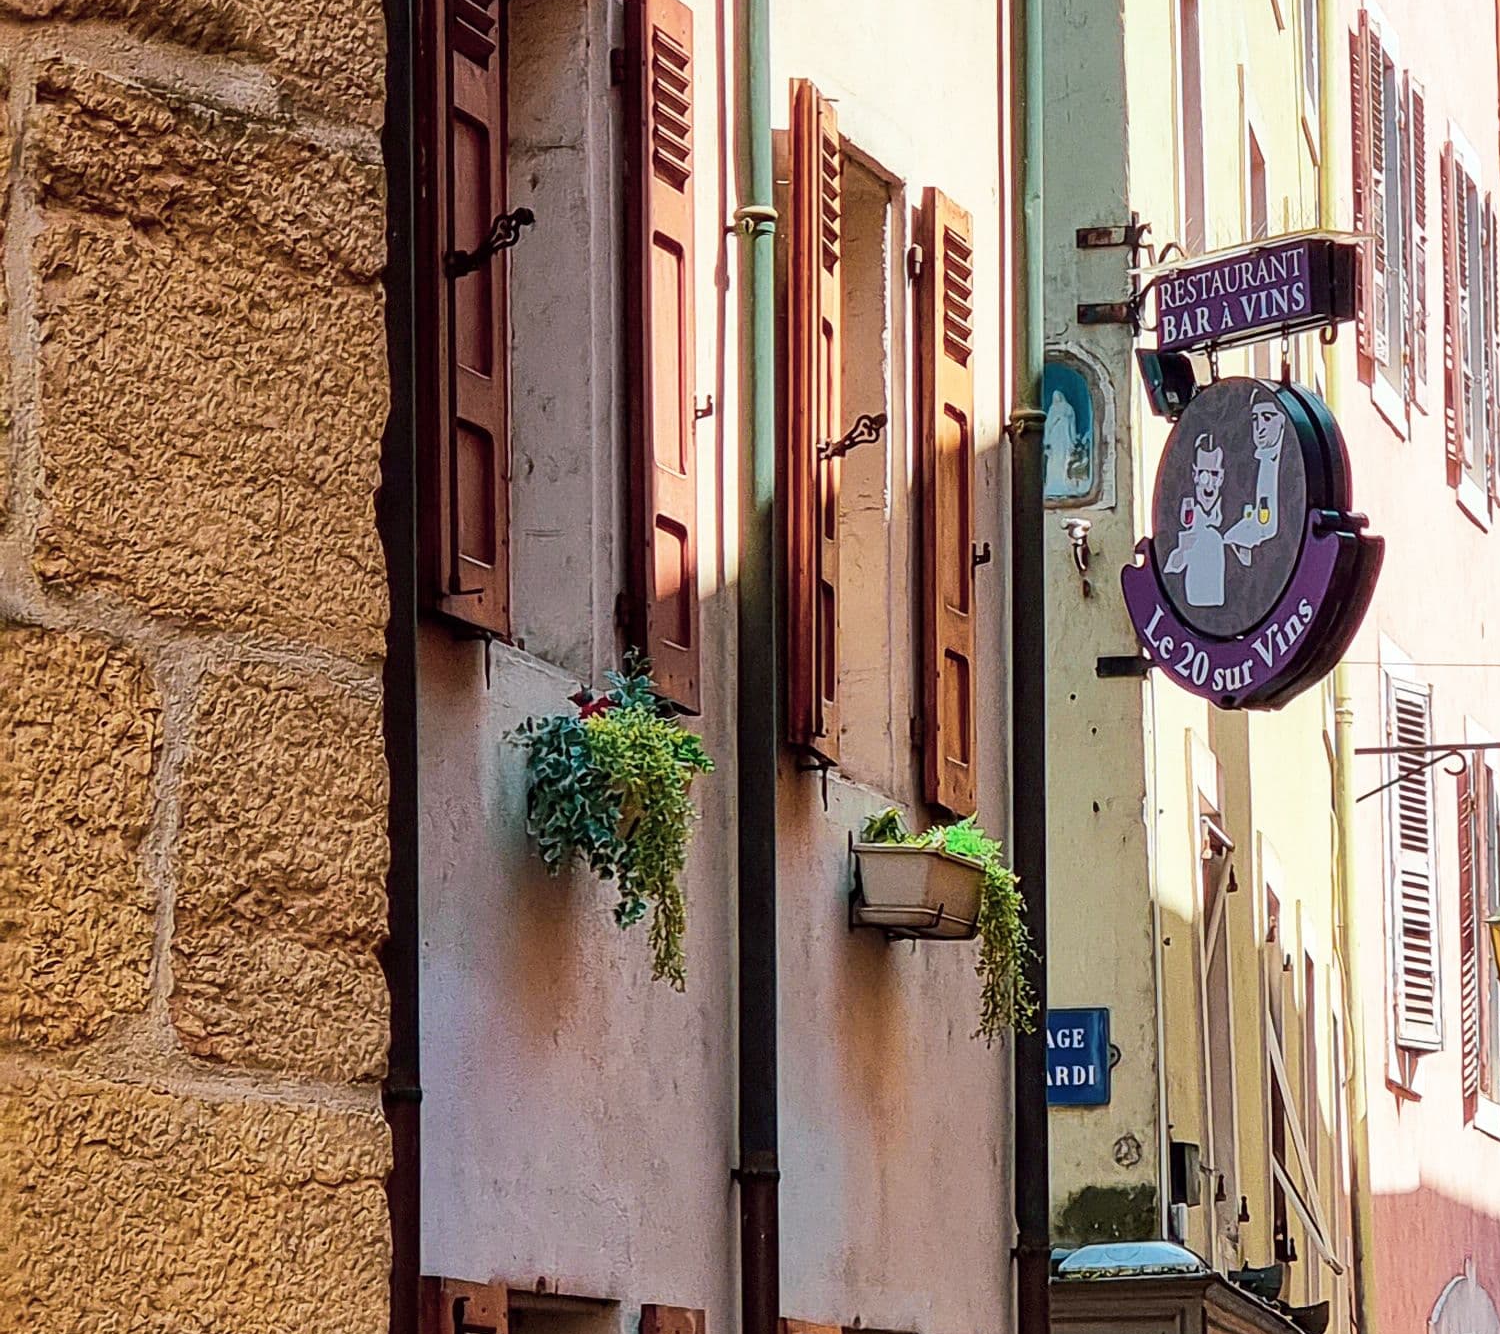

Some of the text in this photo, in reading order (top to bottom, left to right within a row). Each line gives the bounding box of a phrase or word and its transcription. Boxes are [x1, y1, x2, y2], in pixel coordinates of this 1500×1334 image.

[1160, 248, 1304, 310] RESTAURANT
[1162, 282, 1305, 344] BAR À VINS
[1143, 598, 1313, 692] Le 20 sur Vins
